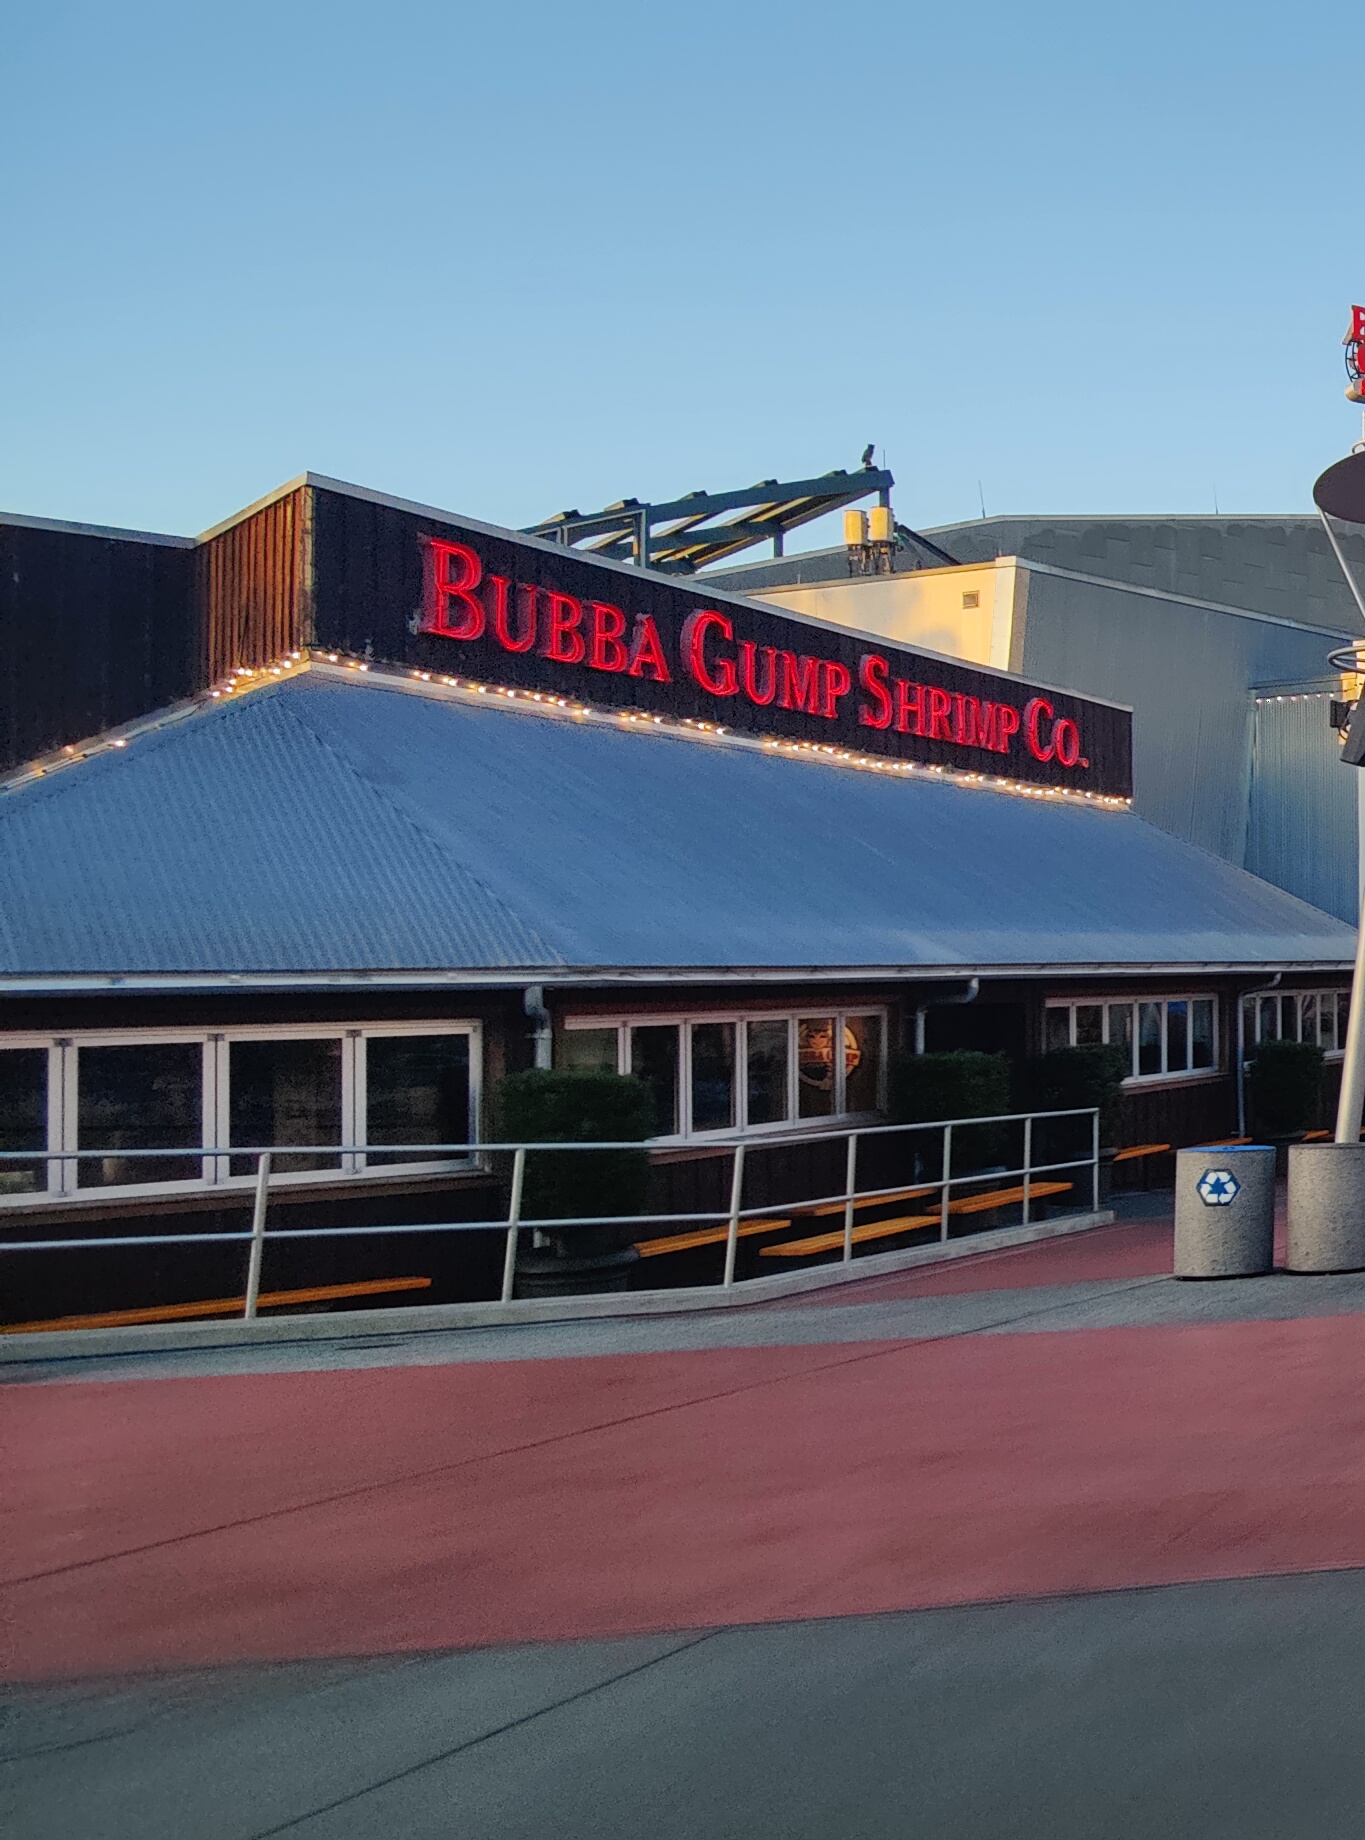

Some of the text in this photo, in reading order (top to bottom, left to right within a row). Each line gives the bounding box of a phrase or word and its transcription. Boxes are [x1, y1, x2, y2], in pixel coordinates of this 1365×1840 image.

[417, 533, 1090, 769] BUBBA GUMP SHRIMP CO.
